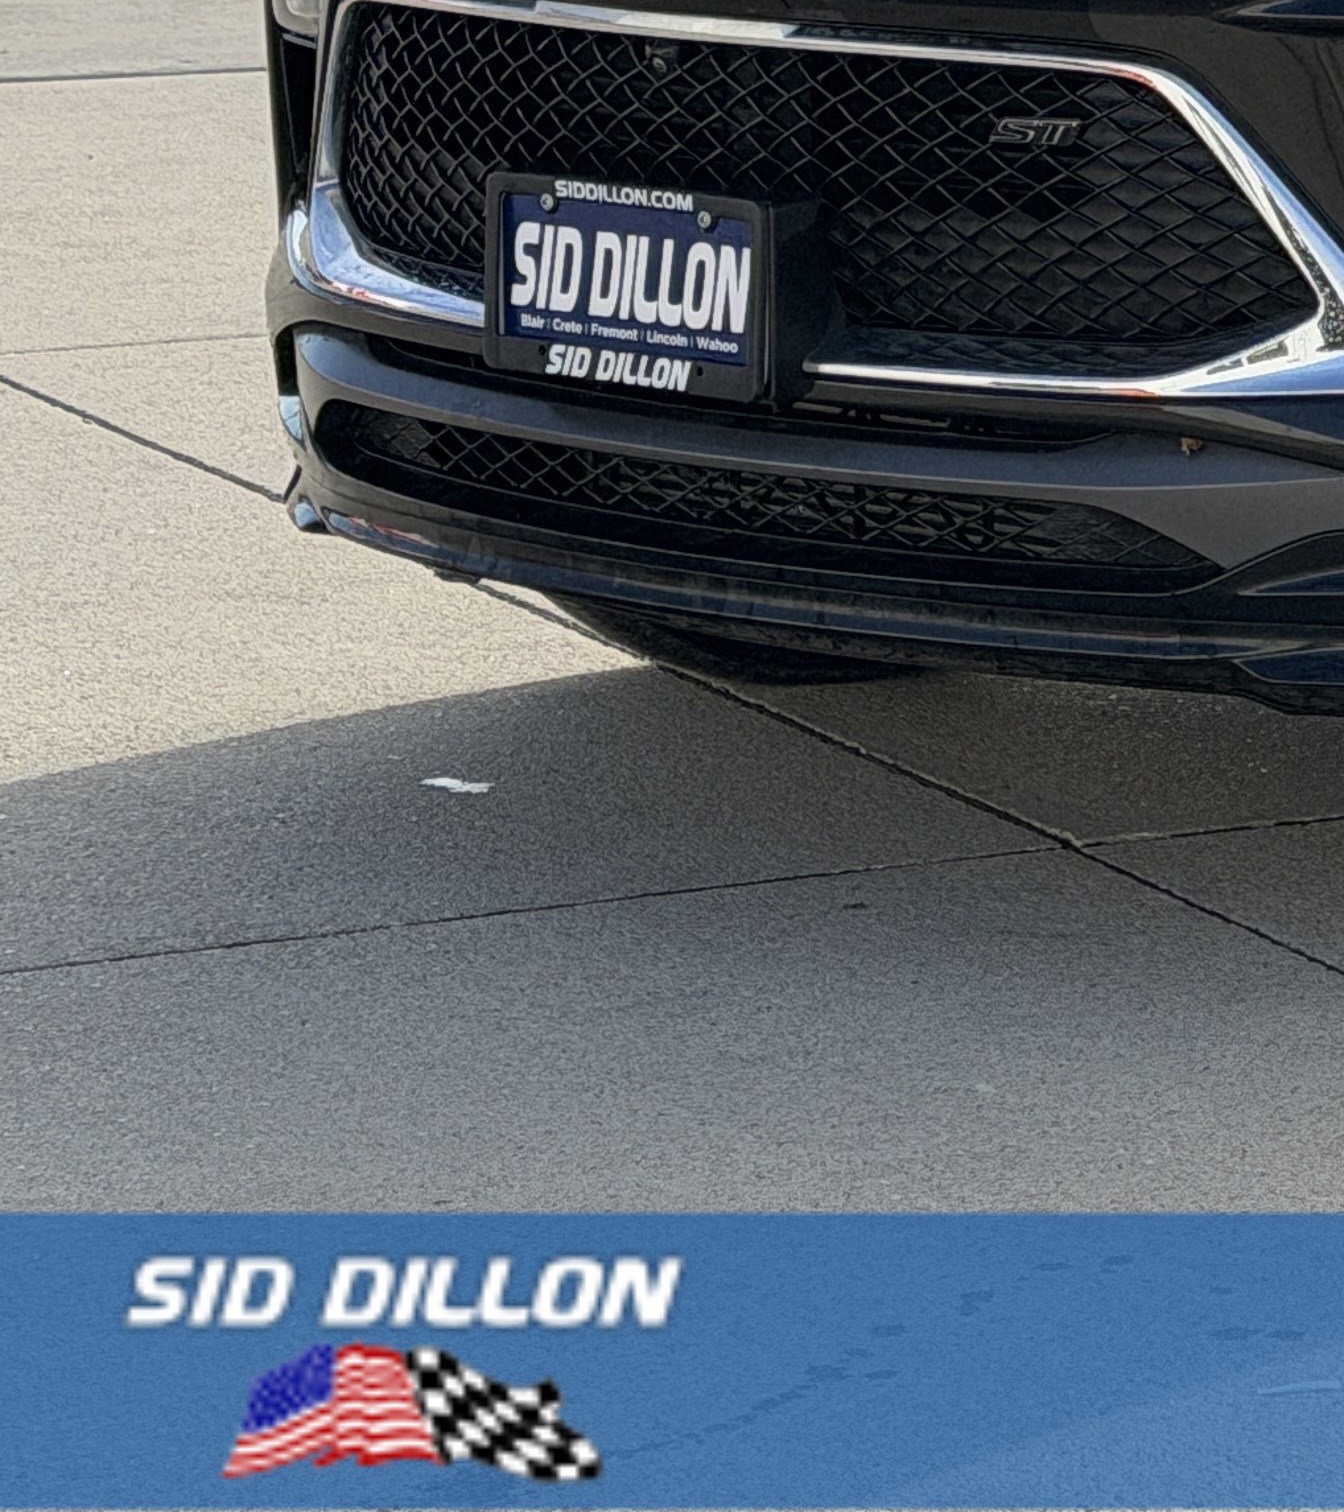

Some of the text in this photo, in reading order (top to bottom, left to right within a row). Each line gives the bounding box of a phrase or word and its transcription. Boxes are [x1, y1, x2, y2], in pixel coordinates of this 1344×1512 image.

[989, 118, 1081, 145] ST
[554, 179, 694, 212] SIDDILLON.COM
[510, 221, 751, 334] SID DILLON
[521, 313, 739, 354] Blair Crete Fremont Lincoln Wahoo
[545, 344, 693, 392] SID DILLON
